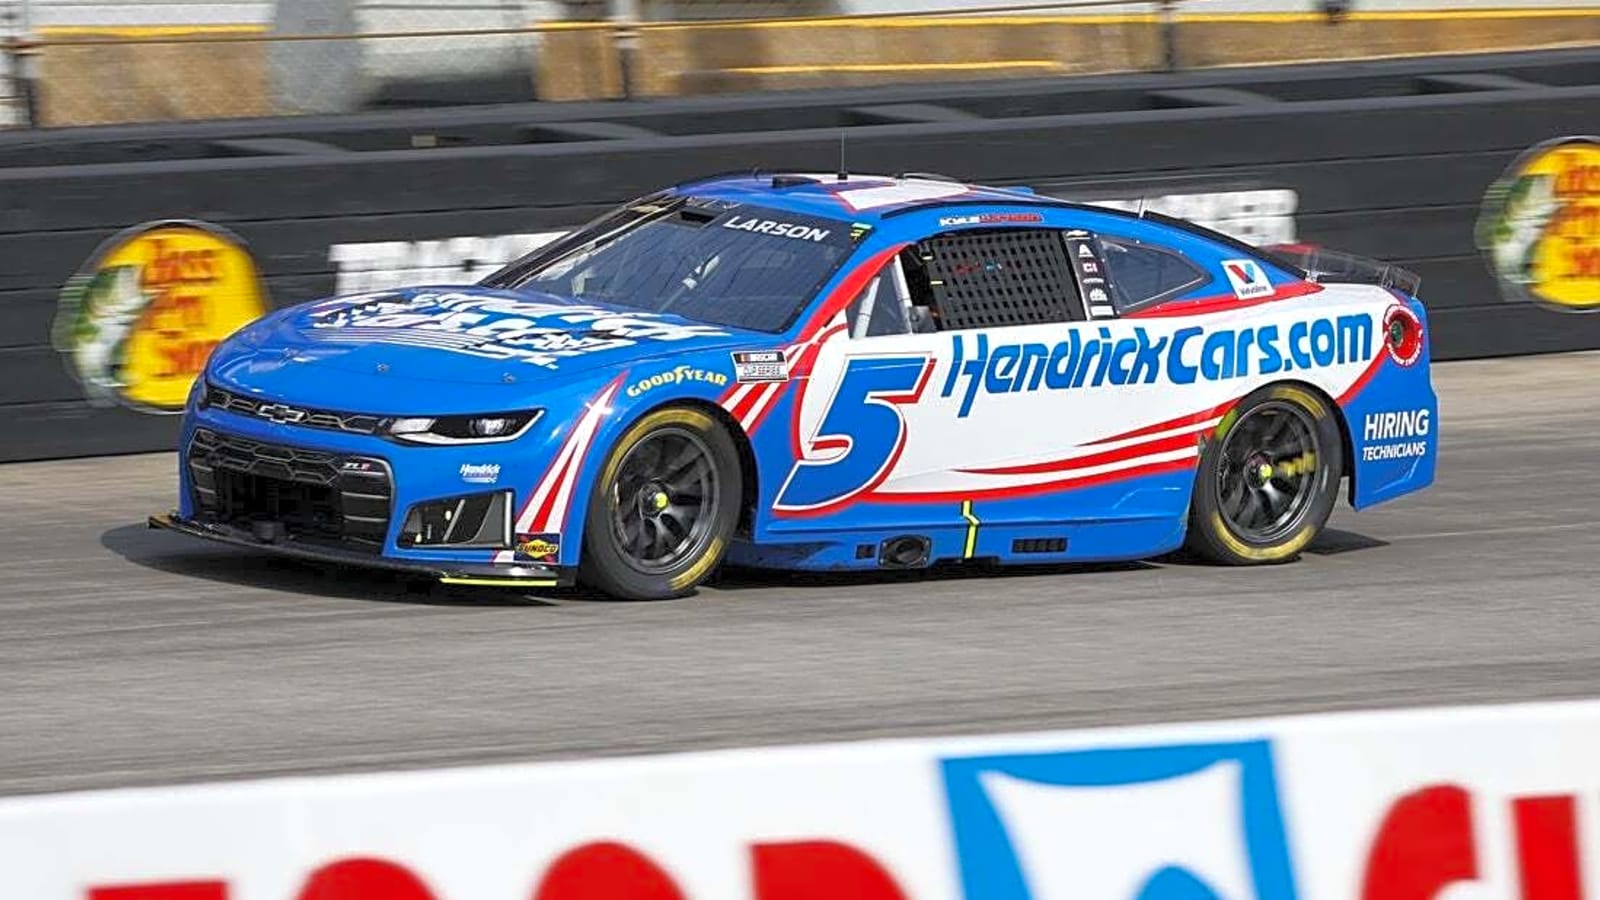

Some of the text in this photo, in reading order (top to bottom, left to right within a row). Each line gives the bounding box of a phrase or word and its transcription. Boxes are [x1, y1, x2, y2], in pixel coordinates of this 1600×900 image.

[723, 215, 831, 241] LARSON
[626, 365, 728, 397] GOODYEAR
[941, 313, 1372, 418] HendrickCars.com
[772, 352, 936, 513] 5
[1364, 408, 1430, 441] HIRING
[1362, 441, 1427, 461] TECHNICIANS
